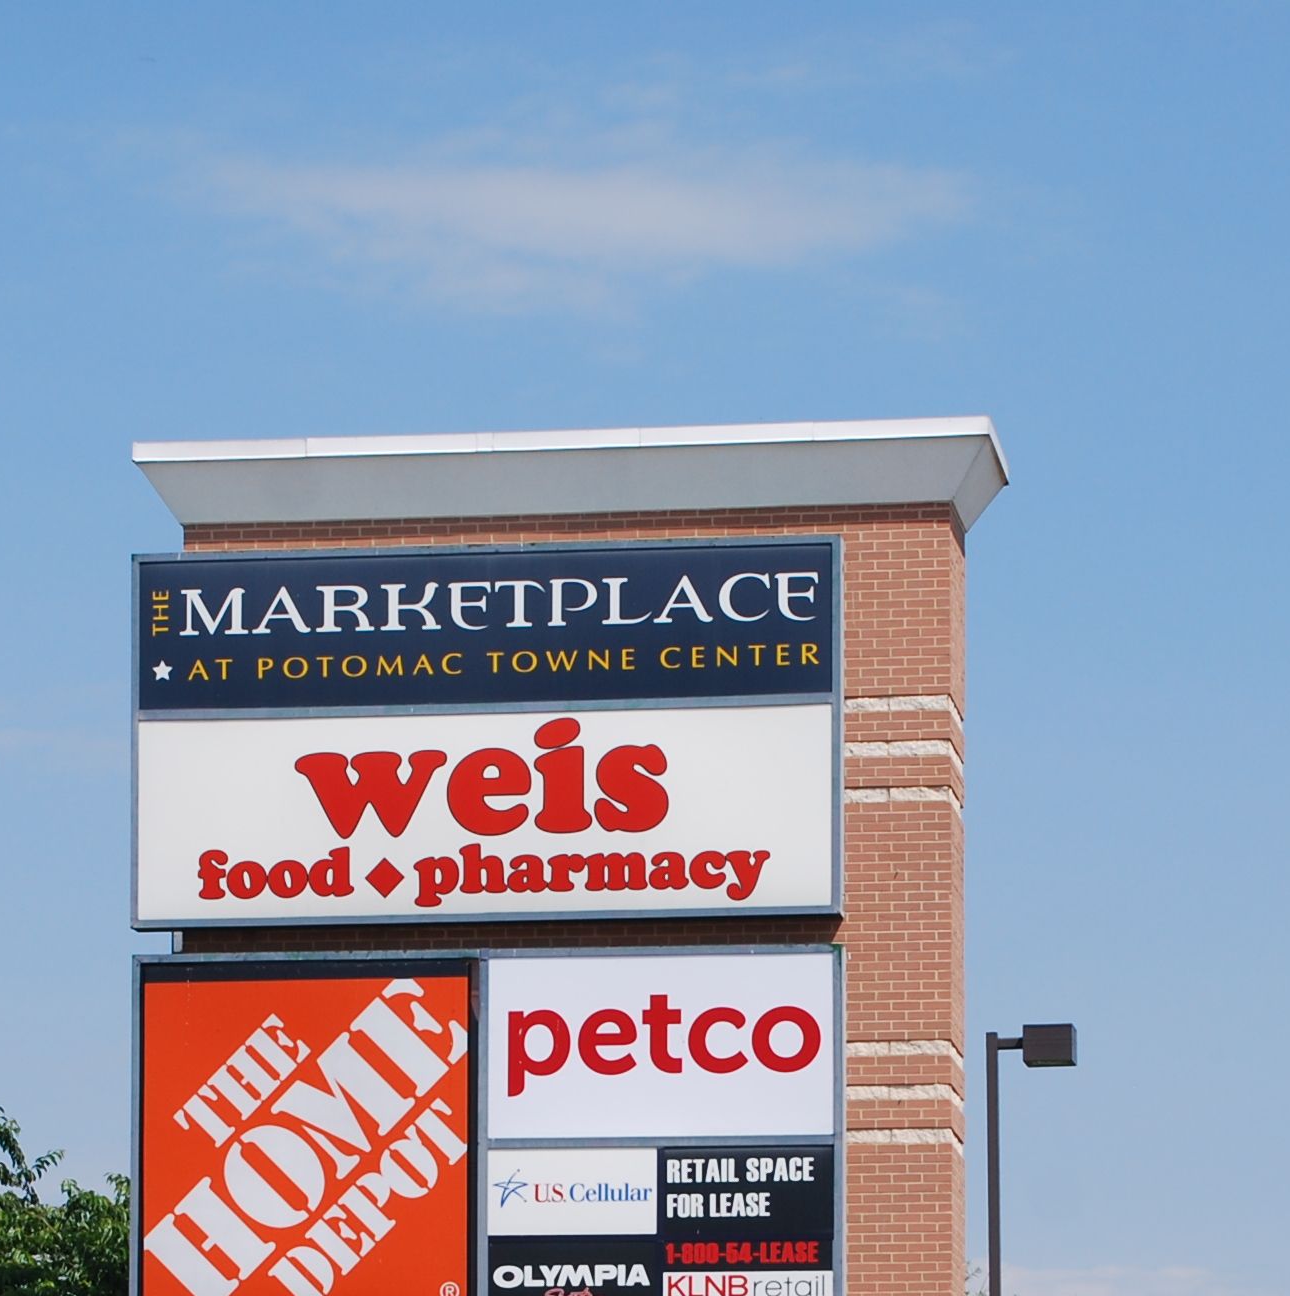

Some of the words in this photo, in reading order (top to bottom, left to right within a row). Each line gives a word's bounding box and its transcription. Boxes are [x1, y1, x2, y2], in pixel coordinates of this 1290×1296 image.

[152, 589, 169, 637] THE
[179, 571, 819, 636] MARKETPLACE
[188, 659, 233, 681] AT
[257, 653, 462, 680] POTOMAC
[486, 648, 636, 674] TOWNE
[659, 643, 820, 669] CENTER
[294, 717, 670, 839] weis
[197, 846, 354, 900] food
[413, 843, 771, 908] pharmacy
[507, 994, 822, 1097] petco
[173, 1013, 311, 1148] THE
[533, 1183, 566, 1203] U.S.
[569, 1182, 653, 1203] Cellular
[666, 1158, 740, 1184] RETAIL
[745, 1156, 815, 1183] SPACE
[666, 1193, 705, 1219] FOR
[709, 1192, 771, 1218] LEASE
[492, 1264, 651, 1289] OLYMPIA
